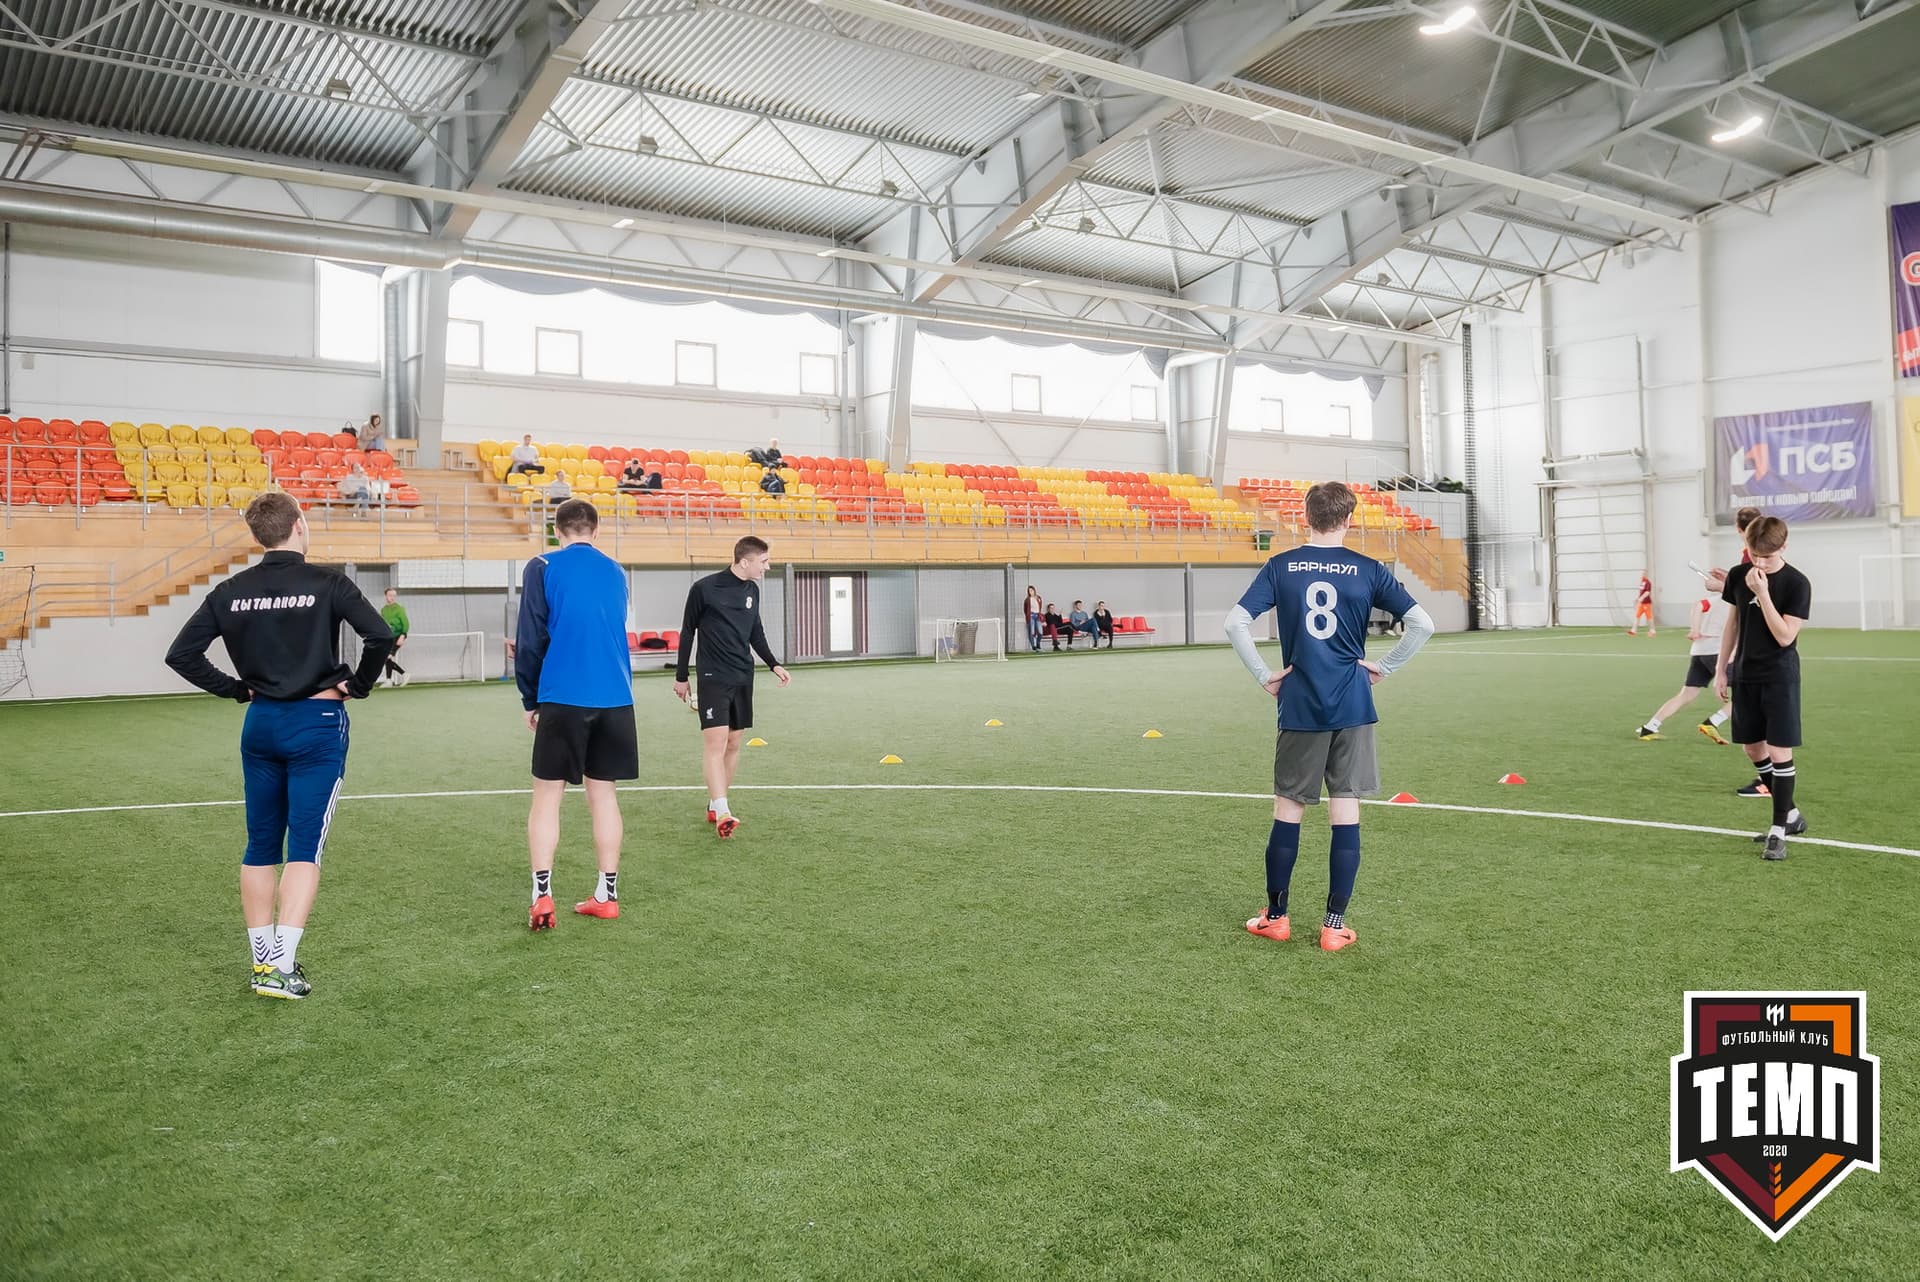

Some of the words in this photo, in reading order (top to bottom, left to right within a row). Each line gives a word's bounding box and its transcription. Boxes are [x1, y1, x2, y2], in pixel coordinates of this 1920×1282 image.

[1778, 440, 1857, 476] ПСБ
[1288, 561, 1358, 576] БАРНАУЛ
[230, 594, 316, 612] КЫТМАНОВО
[1305, 581, 1338, 640] 8
